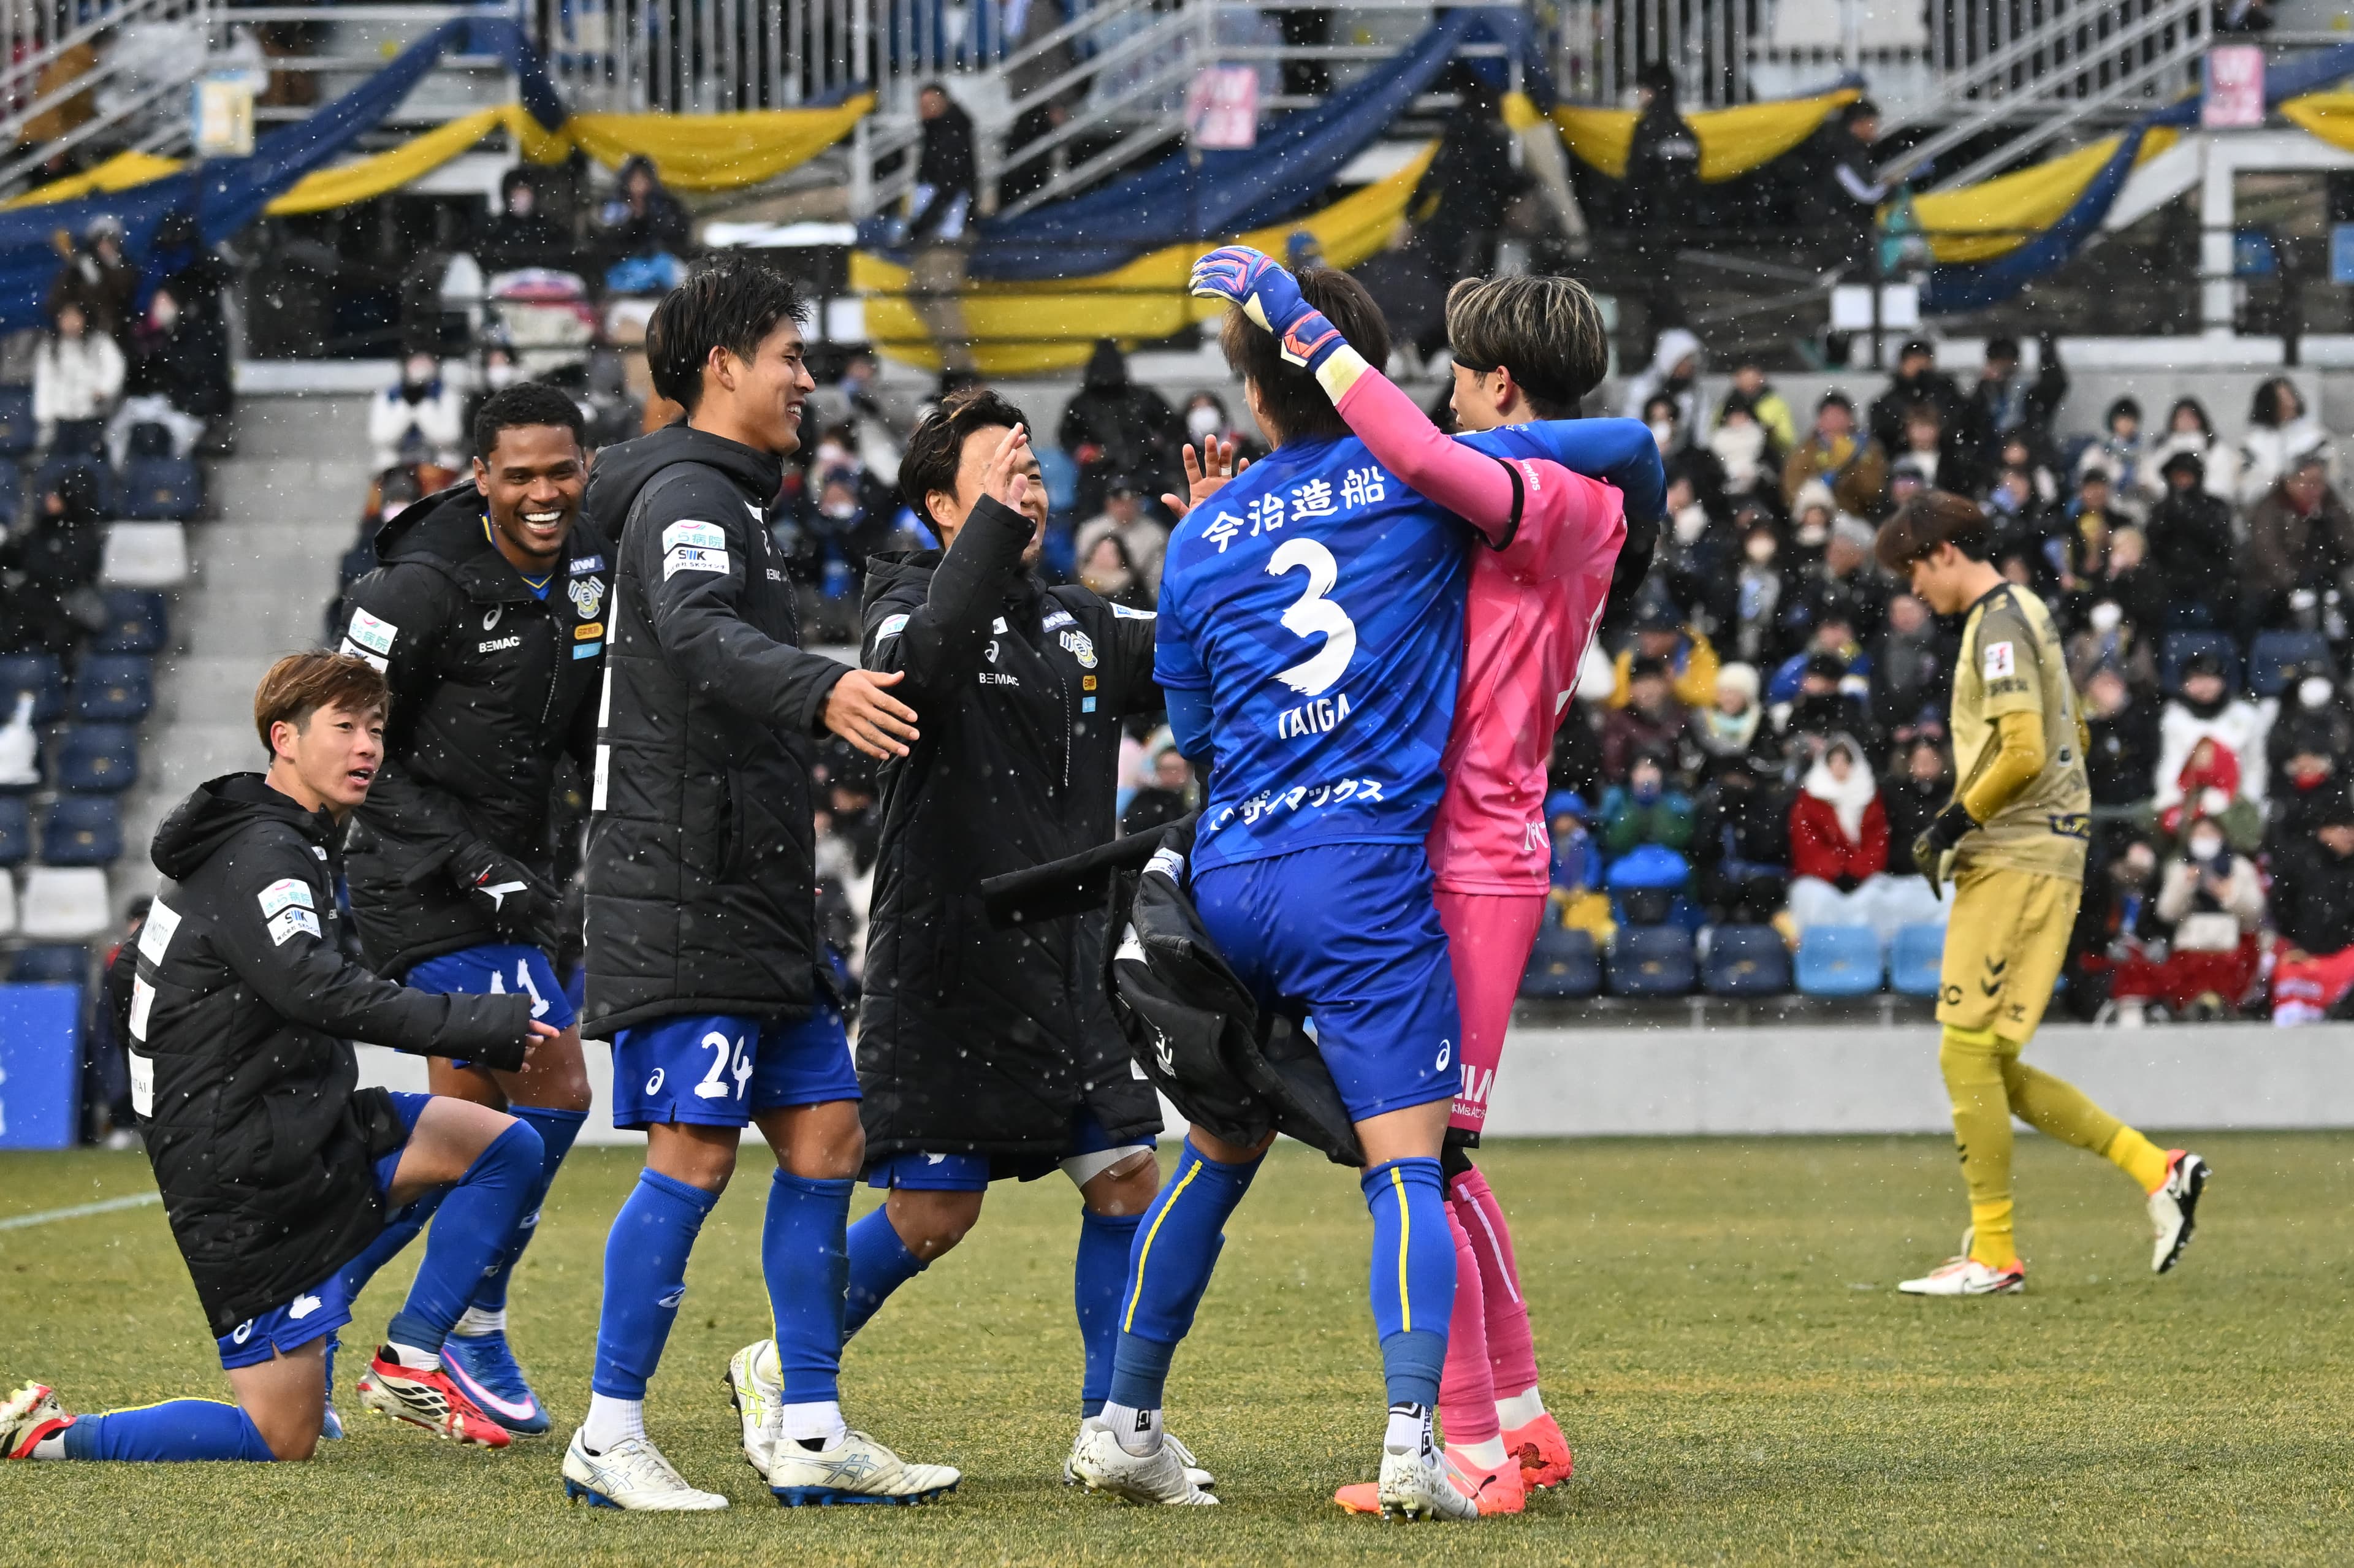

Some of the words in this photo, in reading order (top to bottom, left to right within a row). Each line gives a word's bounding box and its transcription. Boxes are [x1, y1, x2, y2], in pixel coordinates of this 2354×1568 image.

[1202, 466, 1385, 553] 今治造船
[1265, 538, 1357, 696] 3
[479, 636, 520, 653] BEMAC
[979, 672, 1020, 686] BEMAC
[1278, 693, 1350, 740] TAIGA
[1240, 778, 1384, 826] ザイマックス
[694, 1031, 753, 1101] 24
